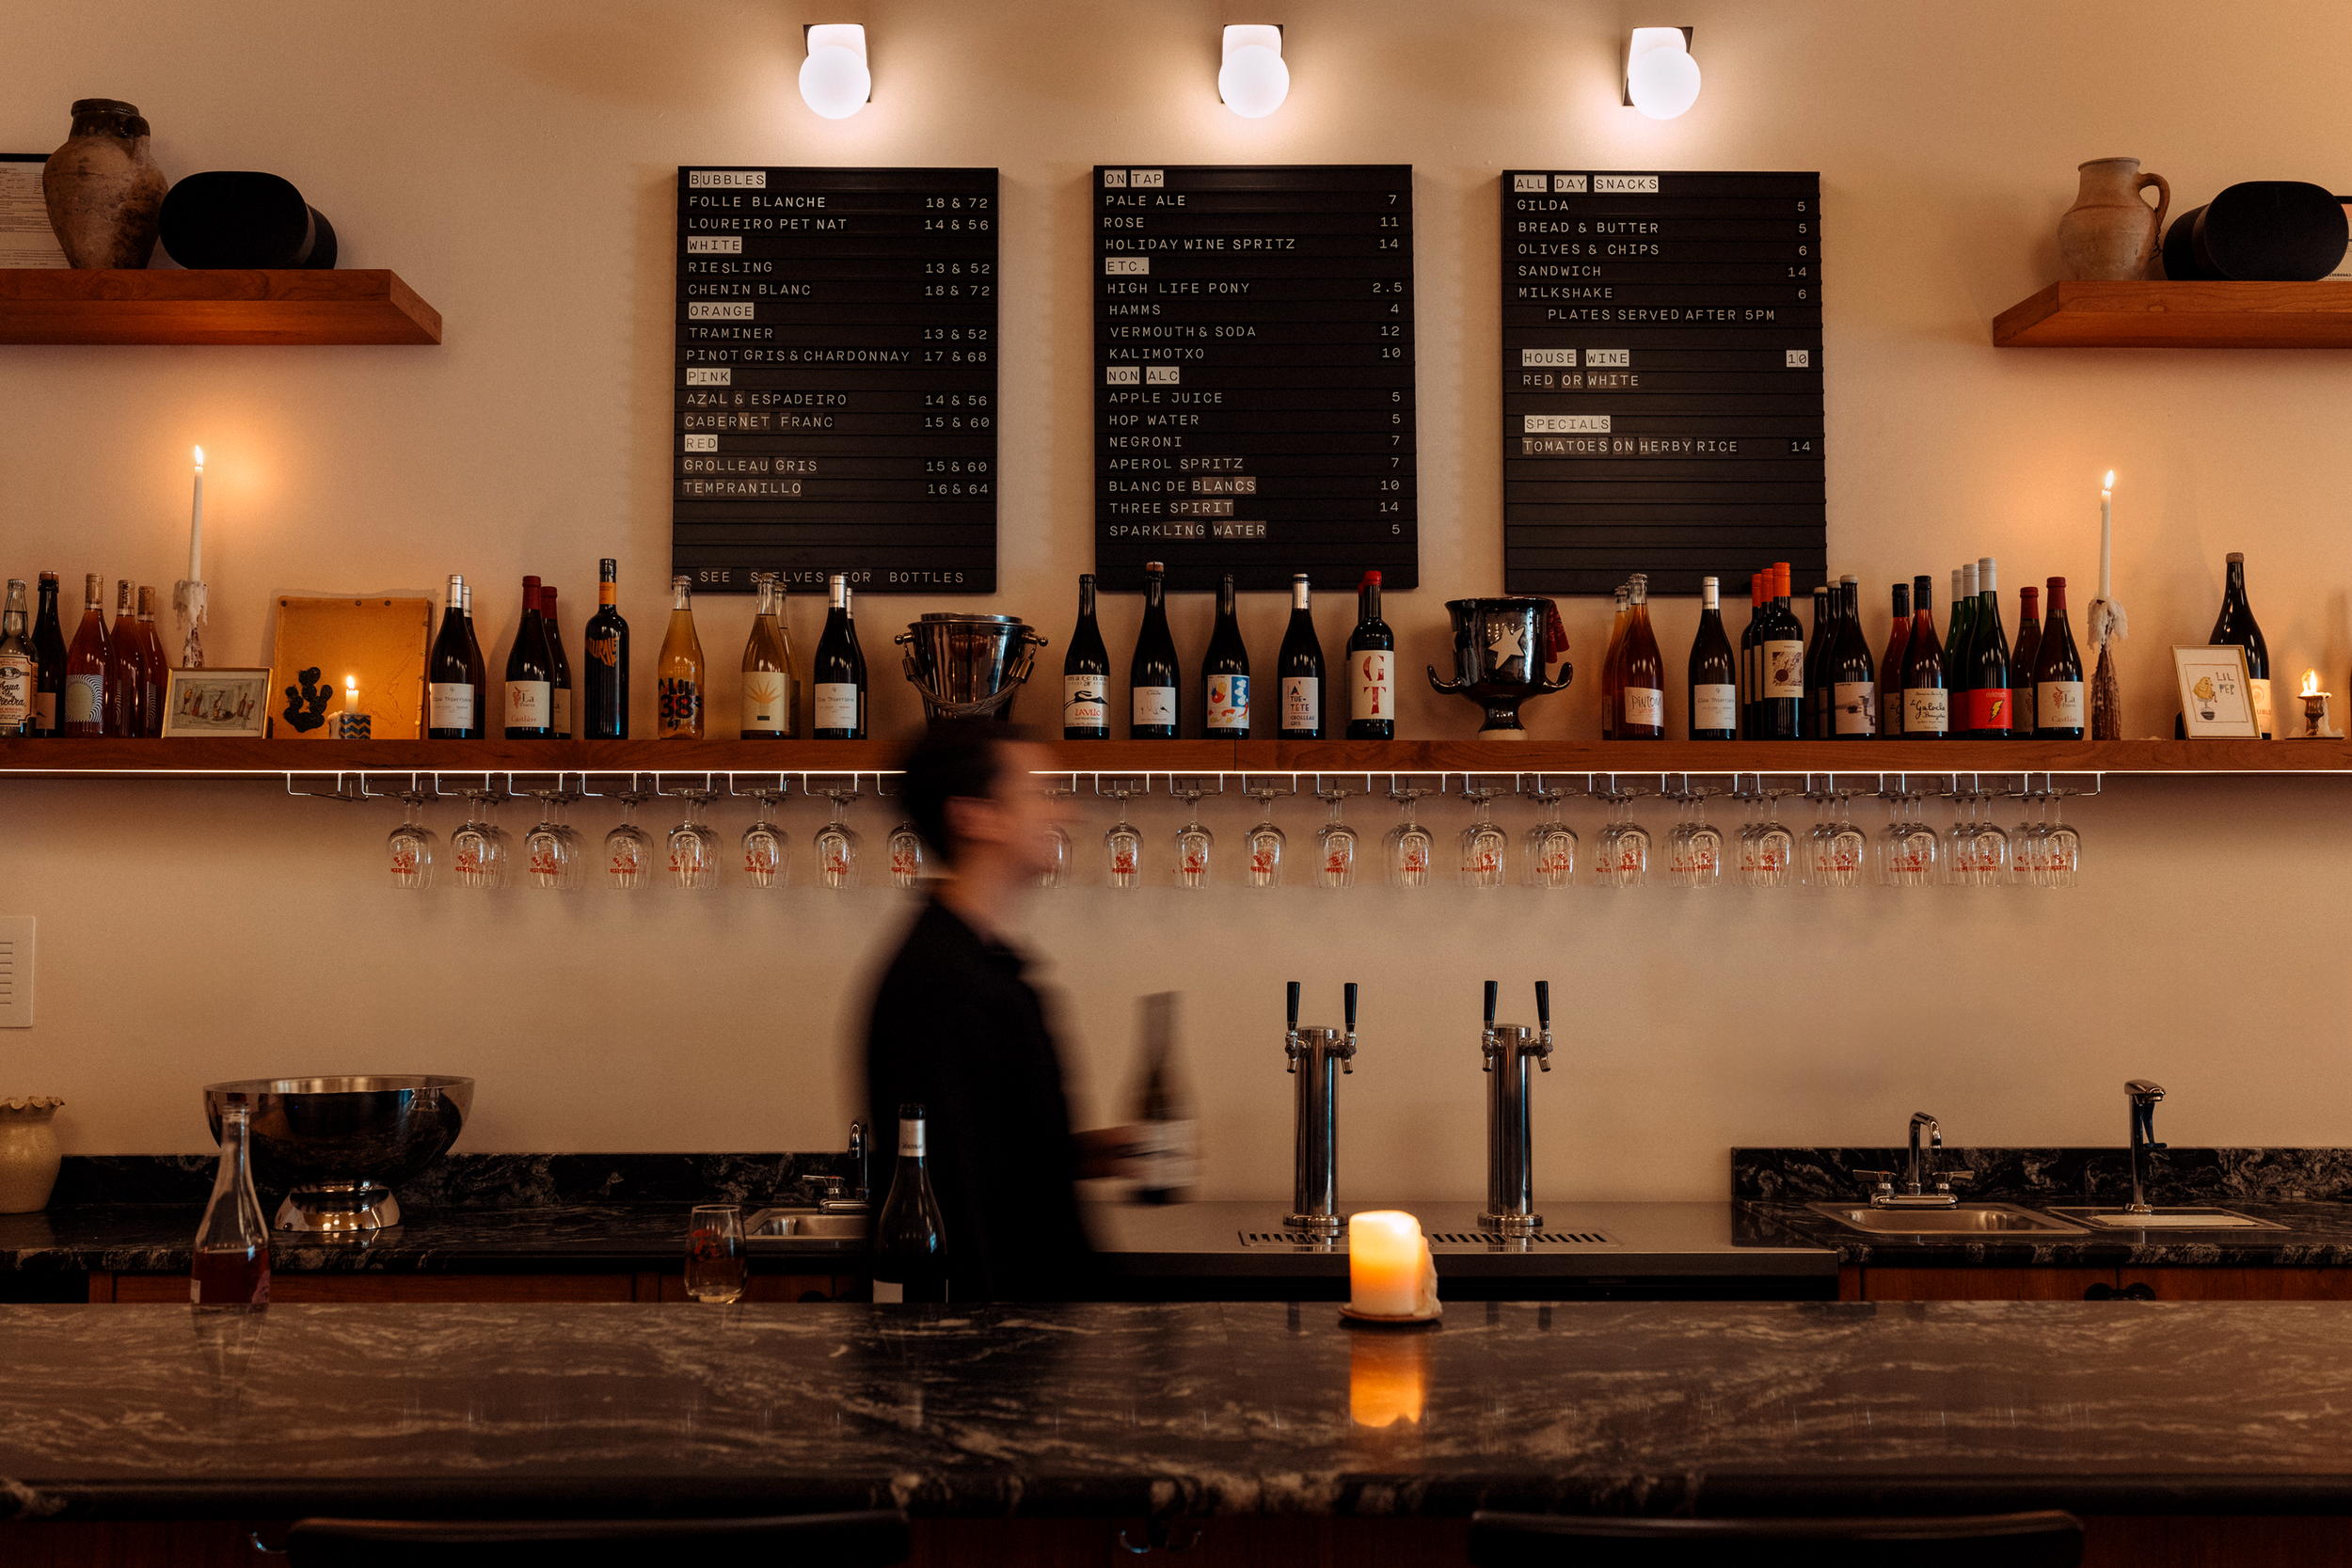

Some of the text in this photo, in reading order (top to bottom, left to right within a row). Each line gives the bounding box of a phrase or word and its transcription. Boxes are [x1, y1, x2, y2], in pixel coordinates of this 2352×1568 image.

[691, 175, 764, 184] BUBBLES
[1105, 174, 1162, 184] ON TAP
[1516, 179, 1657, 189] ALL DAY SNACKS
[691, 197, 987, 208] FOLLE BLANCHE 18 & 72
[1106, 195, 1397, 205] PALE ALE 7
[1518, 200, 1806, 211] GILDA 5
[690, 218, 988, 230] LOUREIRO PET NAT 14 & 56
[1104, 217, 1398, 228] ROSE 11
[1519, 222, 1807, 233] BREAD & BUTTER 5
[689, 241, 740, 250] WHITE
[1106, 239, 1398, 249] HOLIDAY WINE SPRITZ 14
[1518, 244, 1807, 255] OLIVES & CHIPS 6
[690, 262, 989, 274] RIESLING 13 & 52
[1107, 261, 1147, 272] ETC.
[1519, 266, 1806, 277] SANDWICH 14
[689, 284, 989, 295] CHENIN BLANC 18 & 72
[1108, 282, 1402, 293] HIGH LIFE PONY 2.5
[1519, 288, 1807, 299] MILKSHAKE 6
[690, 306, 753, 316] ORANGE
[1110, 304, 1399, 314] HAMMS 4
[1549, 309, 1773, 320] PLATES SERVED AFTER 5PM
[690, 328, 986, 340] TRAMINER 13 & 52
[1111, 326, 1399, 337] VERMOUTH & SODA 12
[687, 350, 986, 362] PINOT GRIS & CHARDONNAY 17 & 68
[1110, 348, 1400, 358] KALIMOTXO 10
[1524, 353, 1806, 363] HOUSE WINE 10
[688, 372, 729, 382] PINK
[1108, 372, 1179, 381] NON ALC
[1524, 375, 1638, 386] RED OR WHITE
[687, 394, 986, 405] AZAL & ESPADEIRO 14 & 56
[1110, 392, 1401, 403] APPLE JUICE 5
[686, 417, 989, 427] CABERNET FRANC 15 & 60
[1110, 414, 1401, 425] HOP WATER 5
[1526, 420, 1610, 429] SPECIALS
[686, 438, 716, 448] RED
[1110, 436, 1400, 447] NEGRONI 7
[1524, 441, 1810, 451] TOMATOES ON HERBY RICE 14
[685, 460, 986, 472] GROLLEAU GRIS 15 & 60
[1110, 458, 1400, 469] APEROL SPRITZ 7
[684, 483, 987, 494] TEMPRANILLO 16 & 64
[1110, 481, 1399, 491] BLANC DE BLANCS 10
[1110, 502, 1398, 513] THREE SPIRIT 14
[1110, 525, 1401, 535] SPARKLING WATER 5
[701, 571, 962, 582] SEE SELVES FOR BOTTLES
[2216, 671, 2234, 681] LIL
[2218, 684, 2234, 695] PEP
[522, 693, 534, 703] La
[2064, 693, 2075, 703] La
